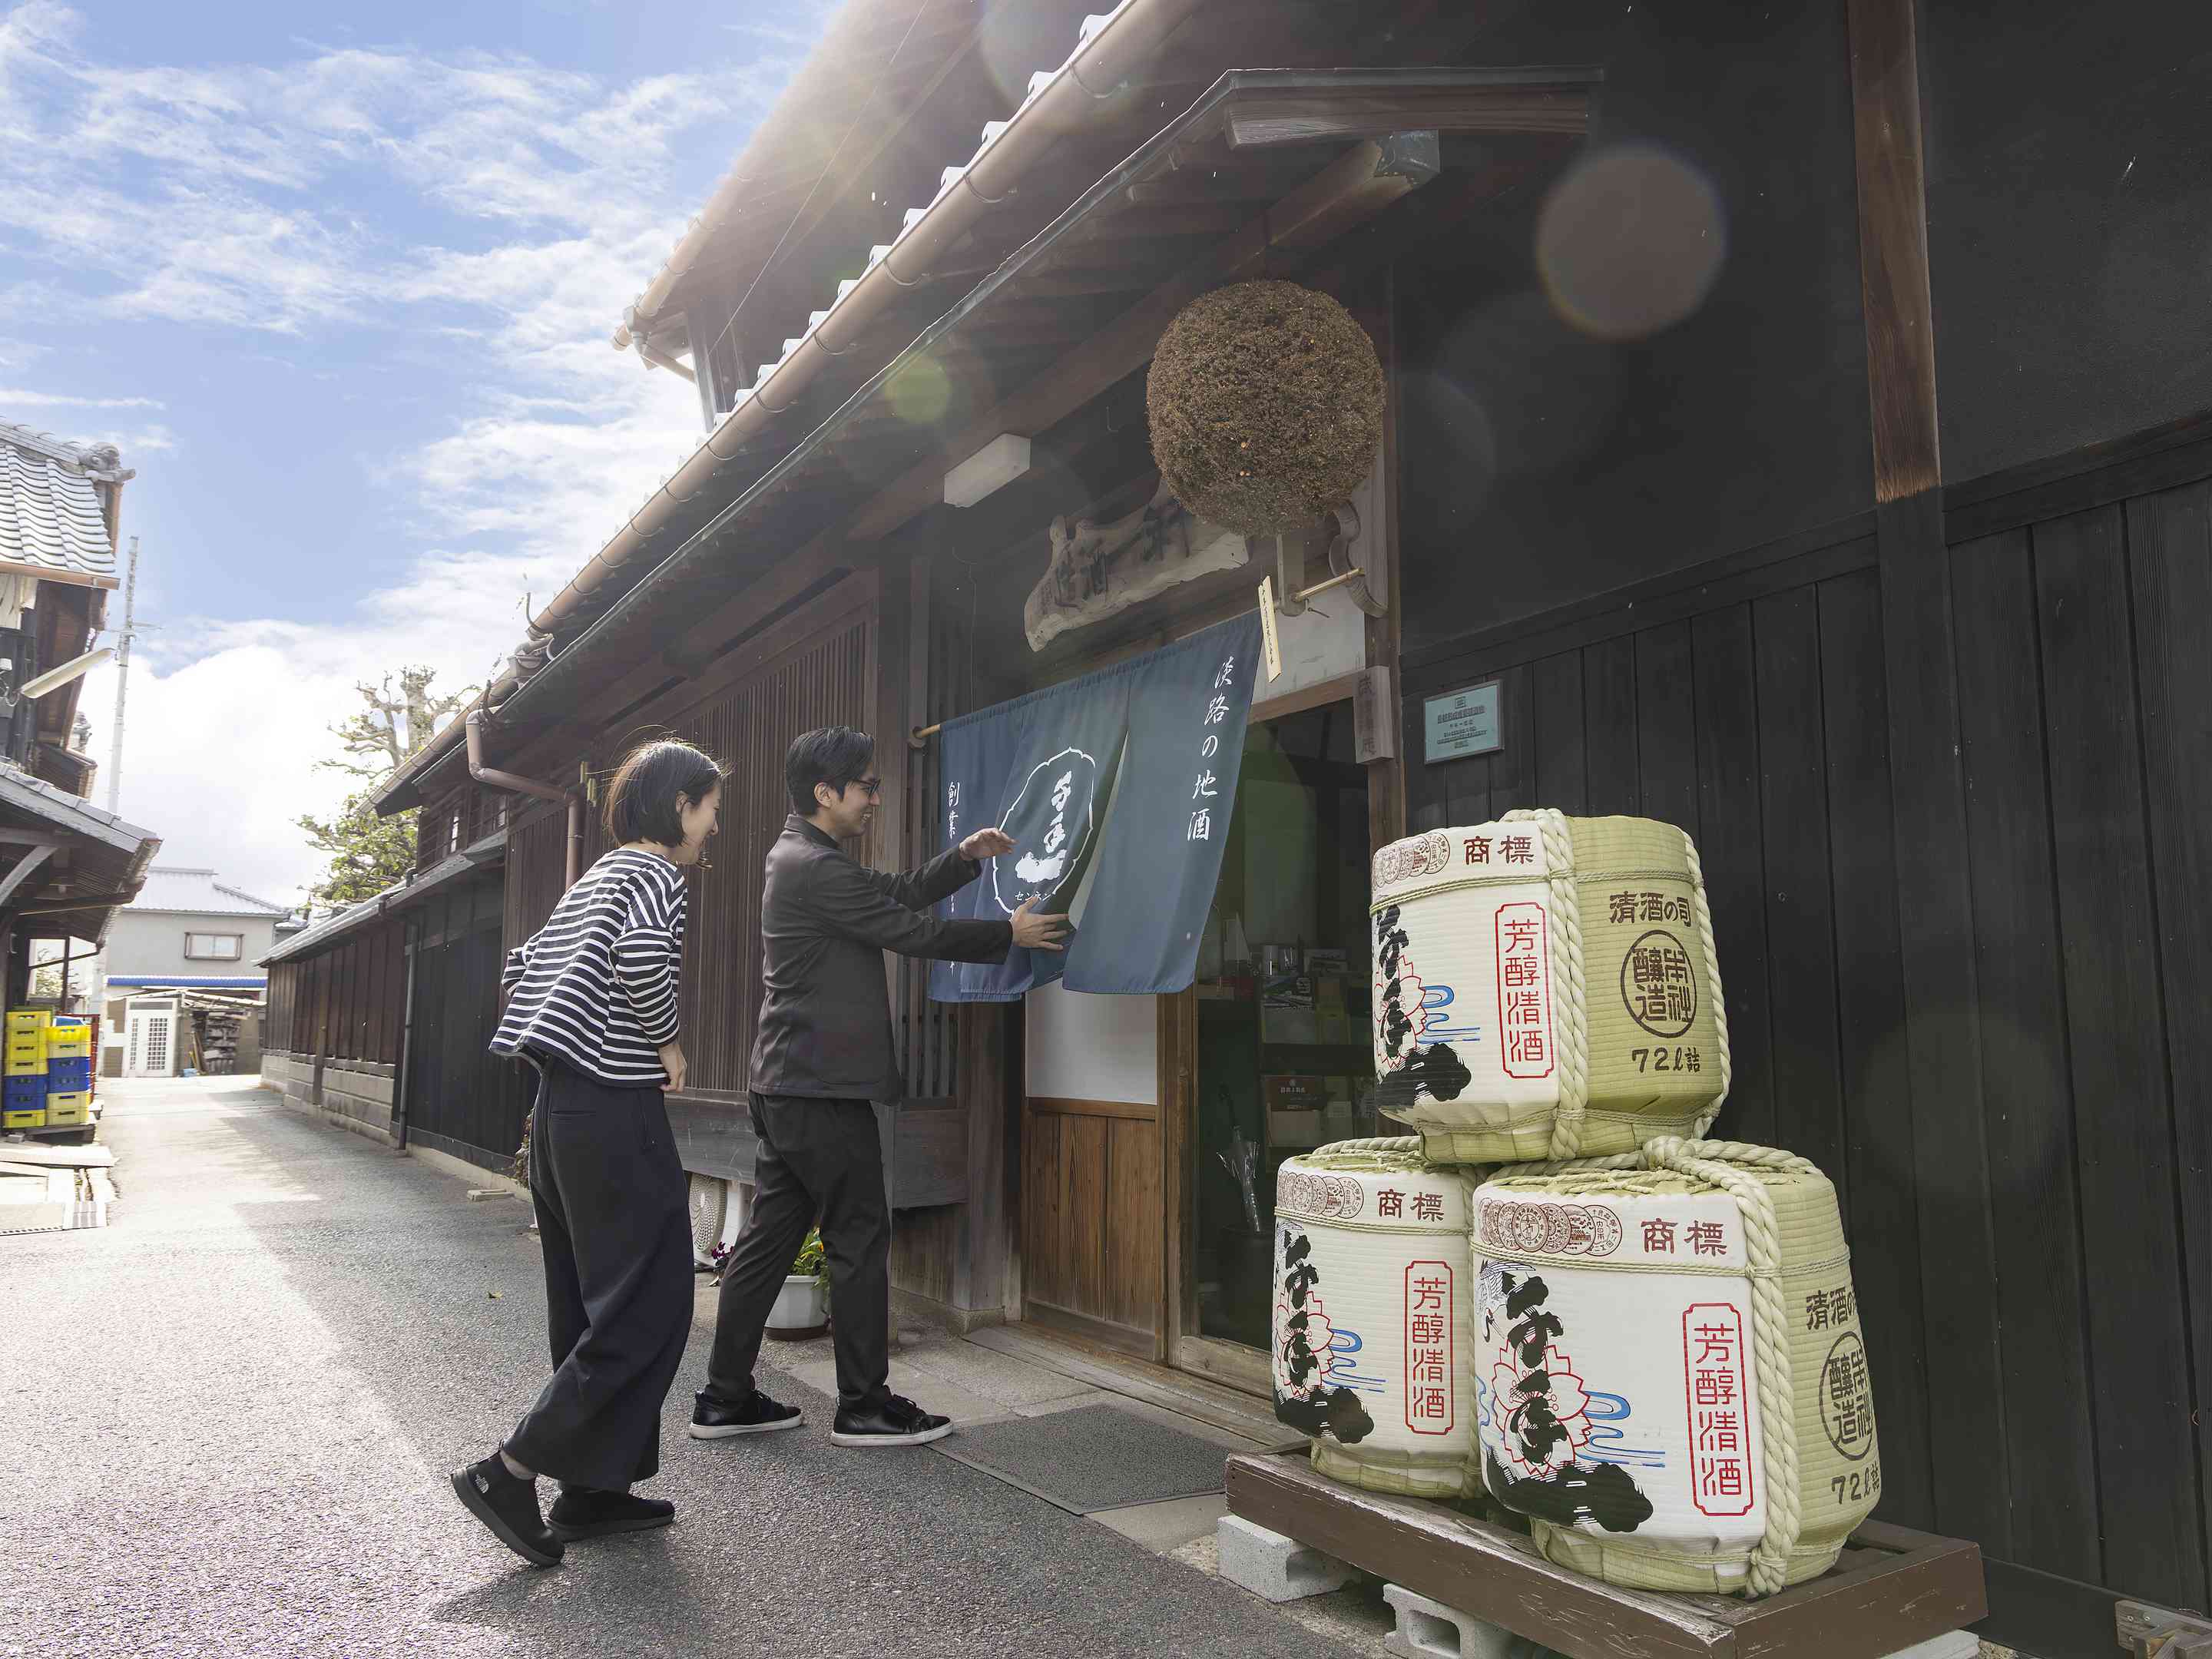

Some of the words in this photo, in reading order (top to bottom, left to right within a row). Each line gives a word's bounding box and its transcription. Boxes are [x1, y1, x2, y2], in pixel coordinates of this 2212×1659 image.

[1187, 656, 1235, 843] 淡路の地酒
[1463, 834, 1535, 866] 商標
[1609, 890, 1691, 928] 清酒の司
[1503, 918, 1545, 1064] 芳醇清酒
[1376, 1187, 1445, 1222] 商標
[1640, 1217, 1729, 1257] 商標
[1412, 1277, 1446, 1421] 芳醇清酒
[1694, 1323, 1742, 1497] 芳醇清酒
